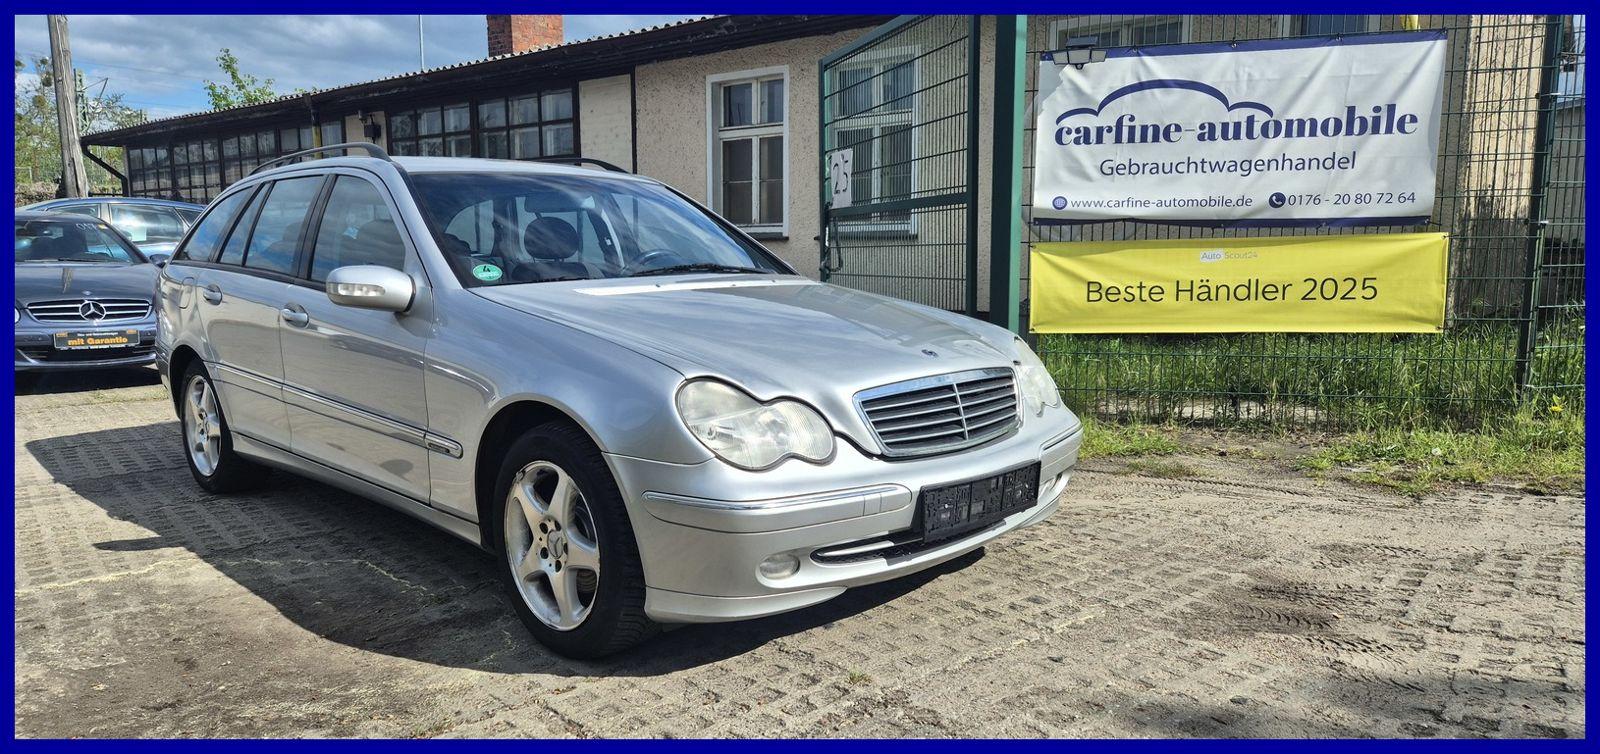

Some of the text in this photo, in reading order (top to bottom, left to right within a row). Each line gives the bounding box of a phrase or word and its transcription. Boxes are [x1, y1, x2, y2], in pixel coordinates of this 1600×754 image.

[1055, 104, 1418, 146] carfine-automobile
[1100, 151, 1357, 177] Gebrauchtwagenhandel
[1071, 195, 1253, 208] www.carfine-automobile.de
[1287, 194, 1321, 207] 0176
[1334, 193, 1351, 206] 20
[1354, 193, 1372, 205] 80
[1376, 192, 1393, 204] 72
[1397, 191, 1416, 204] 64
[1086, 276, 1378, 303] Beste Händler 2025
